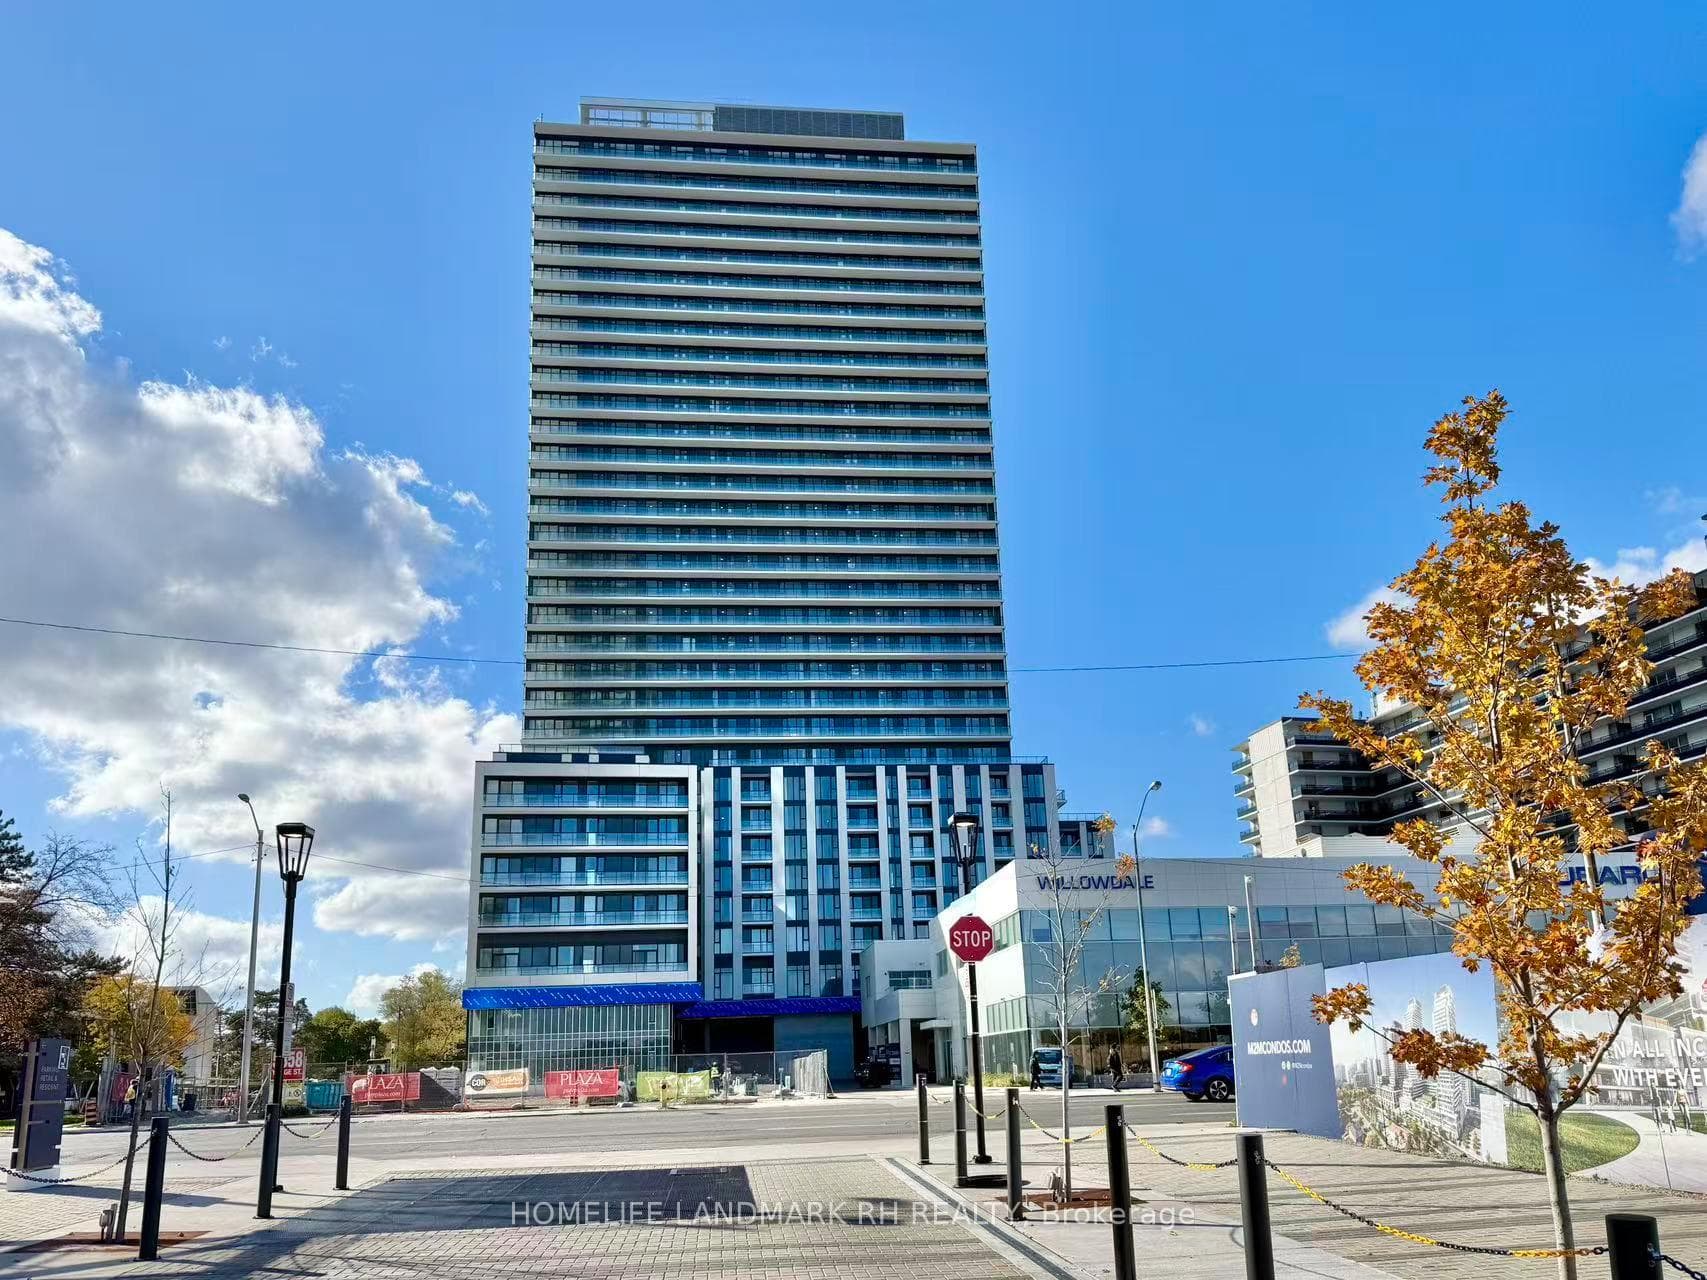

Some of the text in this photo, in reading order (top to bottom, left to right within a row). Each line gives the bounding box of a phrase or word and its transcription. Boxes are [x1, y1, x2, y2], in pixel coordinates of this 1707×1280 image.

[1036, 874, 1154, 891] WILLOWDALE
[953, 930, 991, 948] STOP
[1247, 1039, 1312, 1056] M2MCONDOS.COM
[1633, 1039, 1665, 1058] ALL
[560, 1072, 604, 1086] PLAZA
[1612, 1068, 1659, 1087] WITH
